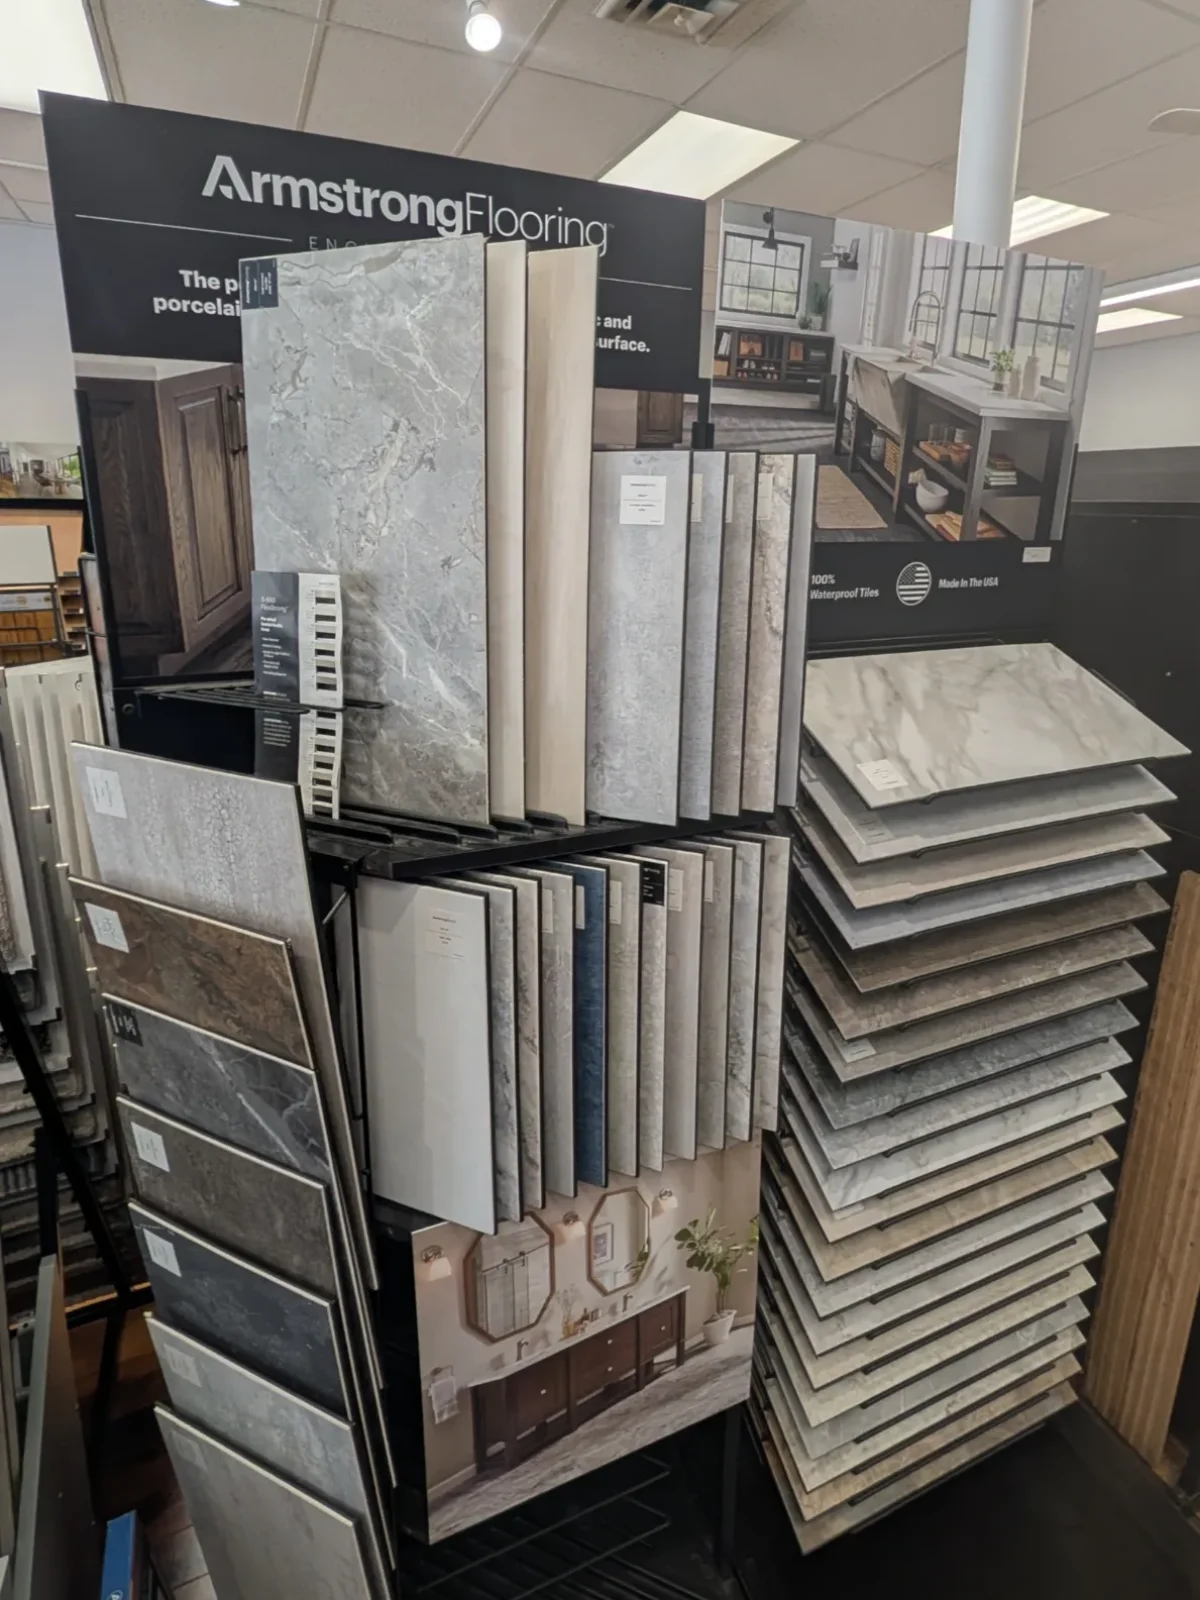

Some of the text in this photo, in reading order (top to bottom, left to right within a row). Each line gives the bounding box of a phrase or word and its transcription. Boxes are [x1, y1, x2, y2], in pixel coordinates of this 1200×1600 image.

[178, 269, 221, 290] The
[224, 277, 241, 295] p
[603, 315, 632, 330] and
[811, 574, 836, 585] 100%
[938, 576, 999, 589] Made In The USA
[810, 586, 880, 601] Waterproof Tiles
